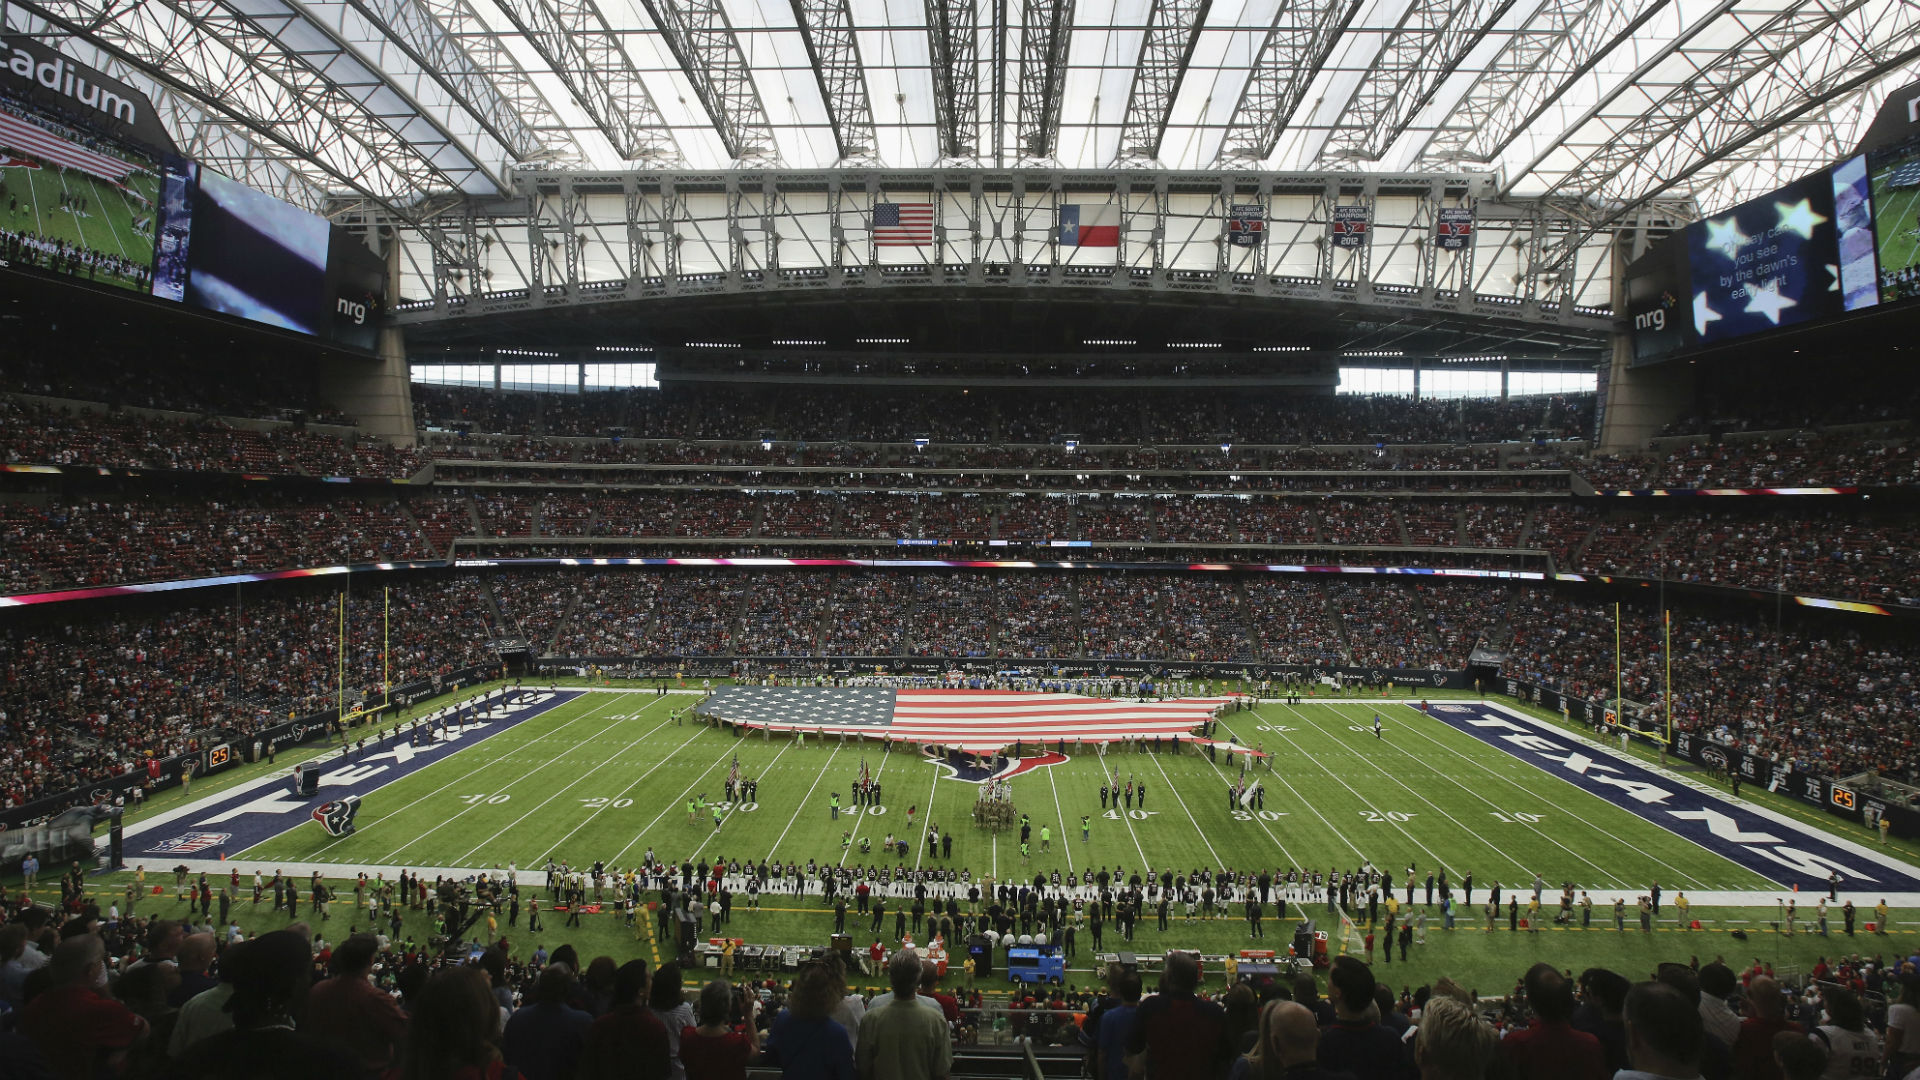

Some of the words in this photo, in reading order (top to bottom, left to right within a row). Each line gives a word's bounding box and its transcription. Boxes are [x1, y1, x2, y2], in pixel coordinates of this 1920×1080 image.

[1341, 237, 1358, 245] 2012
[1445, 239, 1462, 247] 2015
[1735, 252, 1754, 269] you
[1757, 244, 1778, 259] see
[1720, 275, 1733, 288] by
[1736, 269, 1753, 282] the
[1756, 254, 1798, 275] dawn's
[337, 298, 366, 325] nrg
[1635, 309, 1665, 331] nrg
[1606, 711, 1616, 725] 25
[1678, 738, 1689, 751] 24
[212, 749, 227, 765] 25
[1741, 760, 1754, 774] 46
[1806, 782, 1820, 798] 75
[462, 794, 511, 804] 10
[583, 797, 634, 808] 20
[1466, 714, 1881, 883] TEXANS
[1834, 789, 1853, 807] 25
[841, 805, 887, 815] 40
[1102, 808, 1148, 820] 40
[1231, 810, 1279, 821] 30
[1358, 810, 1409, 822] 20
[1489, 812, 1540, 823] 10
